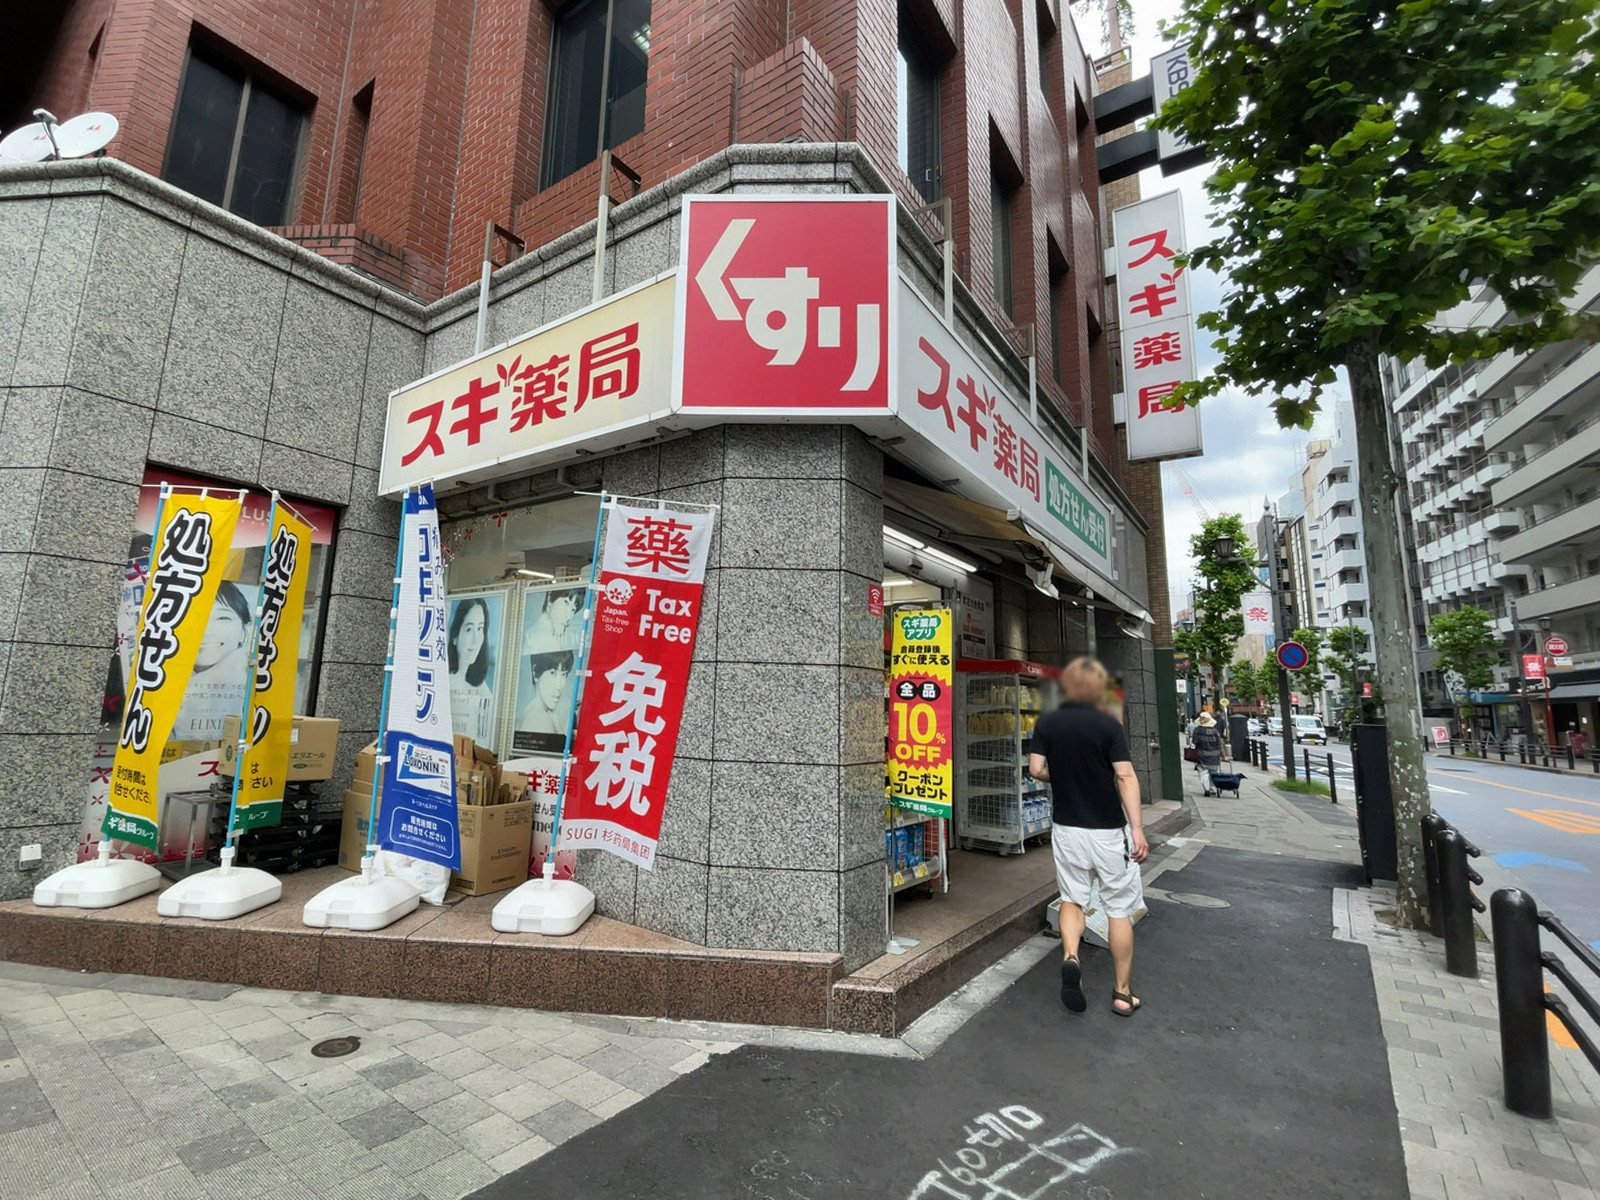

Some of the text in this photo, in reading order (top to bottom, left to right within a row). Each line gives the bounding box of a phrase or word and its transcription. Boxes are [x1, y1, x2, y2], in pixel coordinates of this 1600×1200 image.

[695, 218, 881, 392] くすり
[1127, 228, 1186, 420] スギ薬局
[401, 321, 641, 468] スギ薬局
[917, 335, 1041, 503] スギ薬局
[1049, 468, 1105, 552] 処方せん受付
[625, 515, 693, 575] 藥
[646, 588, 693, 617] Tax
[601, 615, 630, 626] Tax-free
[902, 616, 938, 630] スギ薬局
[1246, 606, 1270, 622] 祭
[121, 507, 212, 754] 処方せん
[604, 624, 624, 634] Shop
[638, 613, 692, 644] Free
[906, 628, 932, 638] アプリ
[900, 645, 941, 654] 会員登録後
[892, 654, 951, 666] すぐに使える
[584, 650, 667, 817] 免税
[895, 744, 942, 762] OFF
[897, 770, 943, 786] クーポン
[893, 782, 948, 800] プレゼント
[566, 828, 599, 841] SUGI
